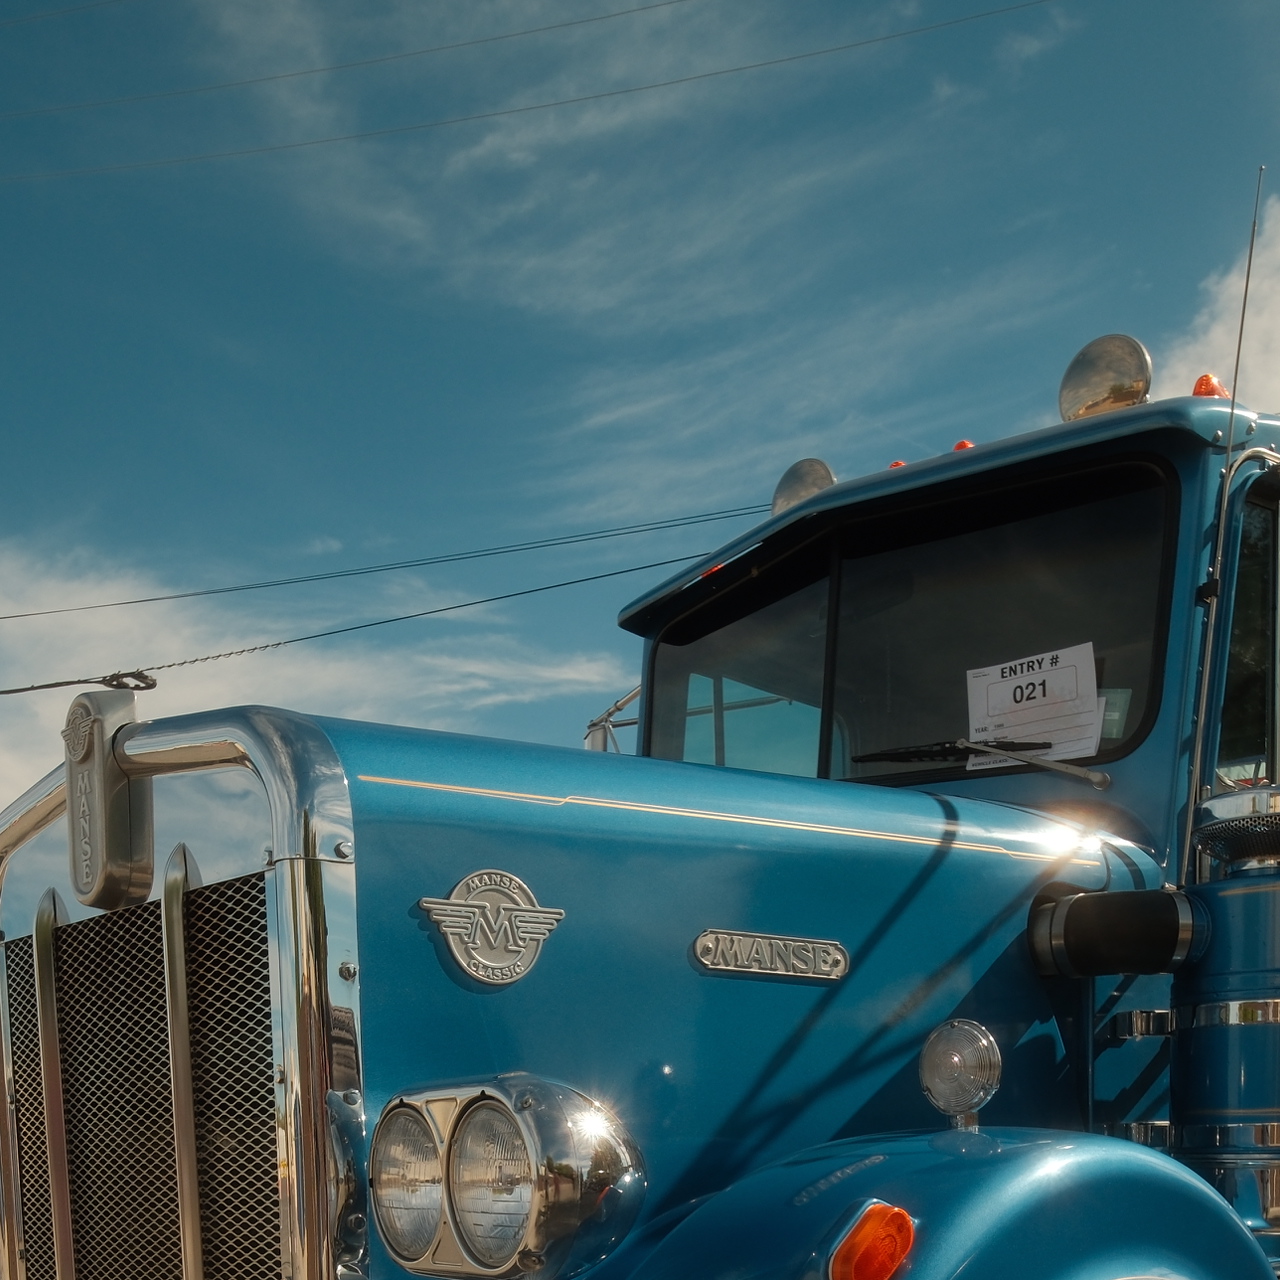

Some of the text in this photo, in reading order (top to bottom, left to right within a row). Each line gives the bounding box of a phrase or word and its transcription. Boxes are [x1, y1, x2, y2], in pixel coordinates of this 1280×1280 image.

[1000, 657, 1045, 679] ENTRY
[1049, 654, 1060, 668] #
[1012, 679, 1048, 704] 021
[76, 770, 93, 885] MANSE
[467, 873, 520, 894] MANSE
[710, 934, 835, 976] MANSE
[469, 959, 525, 981] CLASSIC
